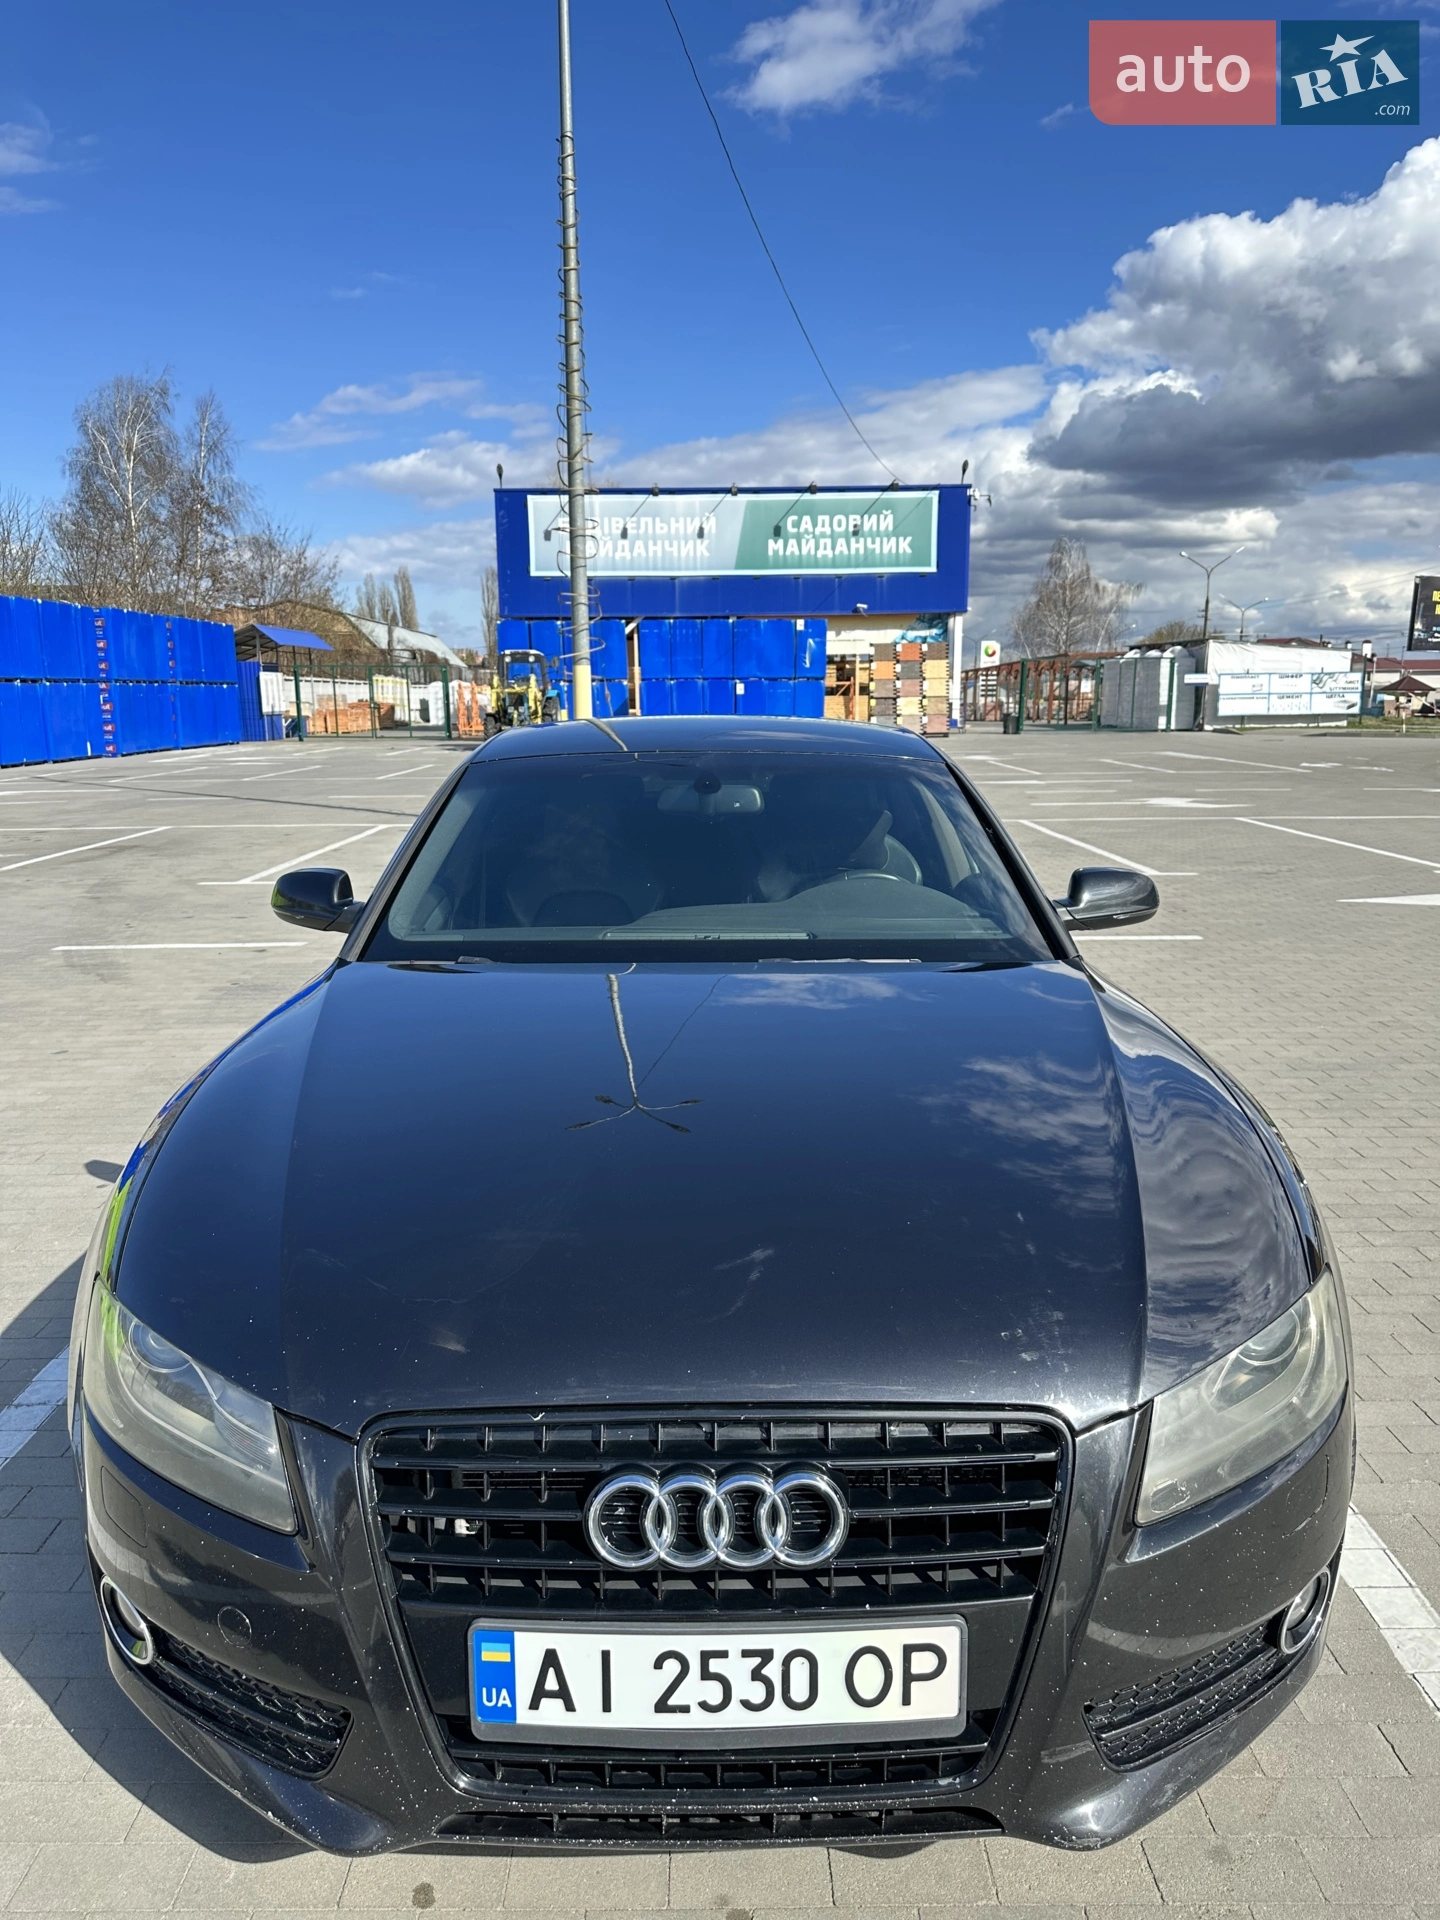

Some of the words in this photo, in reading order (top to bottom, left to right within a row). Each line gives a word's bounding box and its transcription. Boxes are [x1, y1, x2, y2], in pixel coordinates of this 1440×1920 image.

[557, 512, 717, 536] БДІВЕЛЬНИЙ
[786, 509, 894, 535] САДОВИЙ
[565, 536, 711, 560] АЙДАНЧИК
[767, 533, 913, 558] МАЙДАНЧИК
[528, 1647, 612, 1713] AI
[653, 1648, 819, 1714] 2530
[844, 1642, 948, 1709] OP
[482, 1687, 512, 1708] UA
